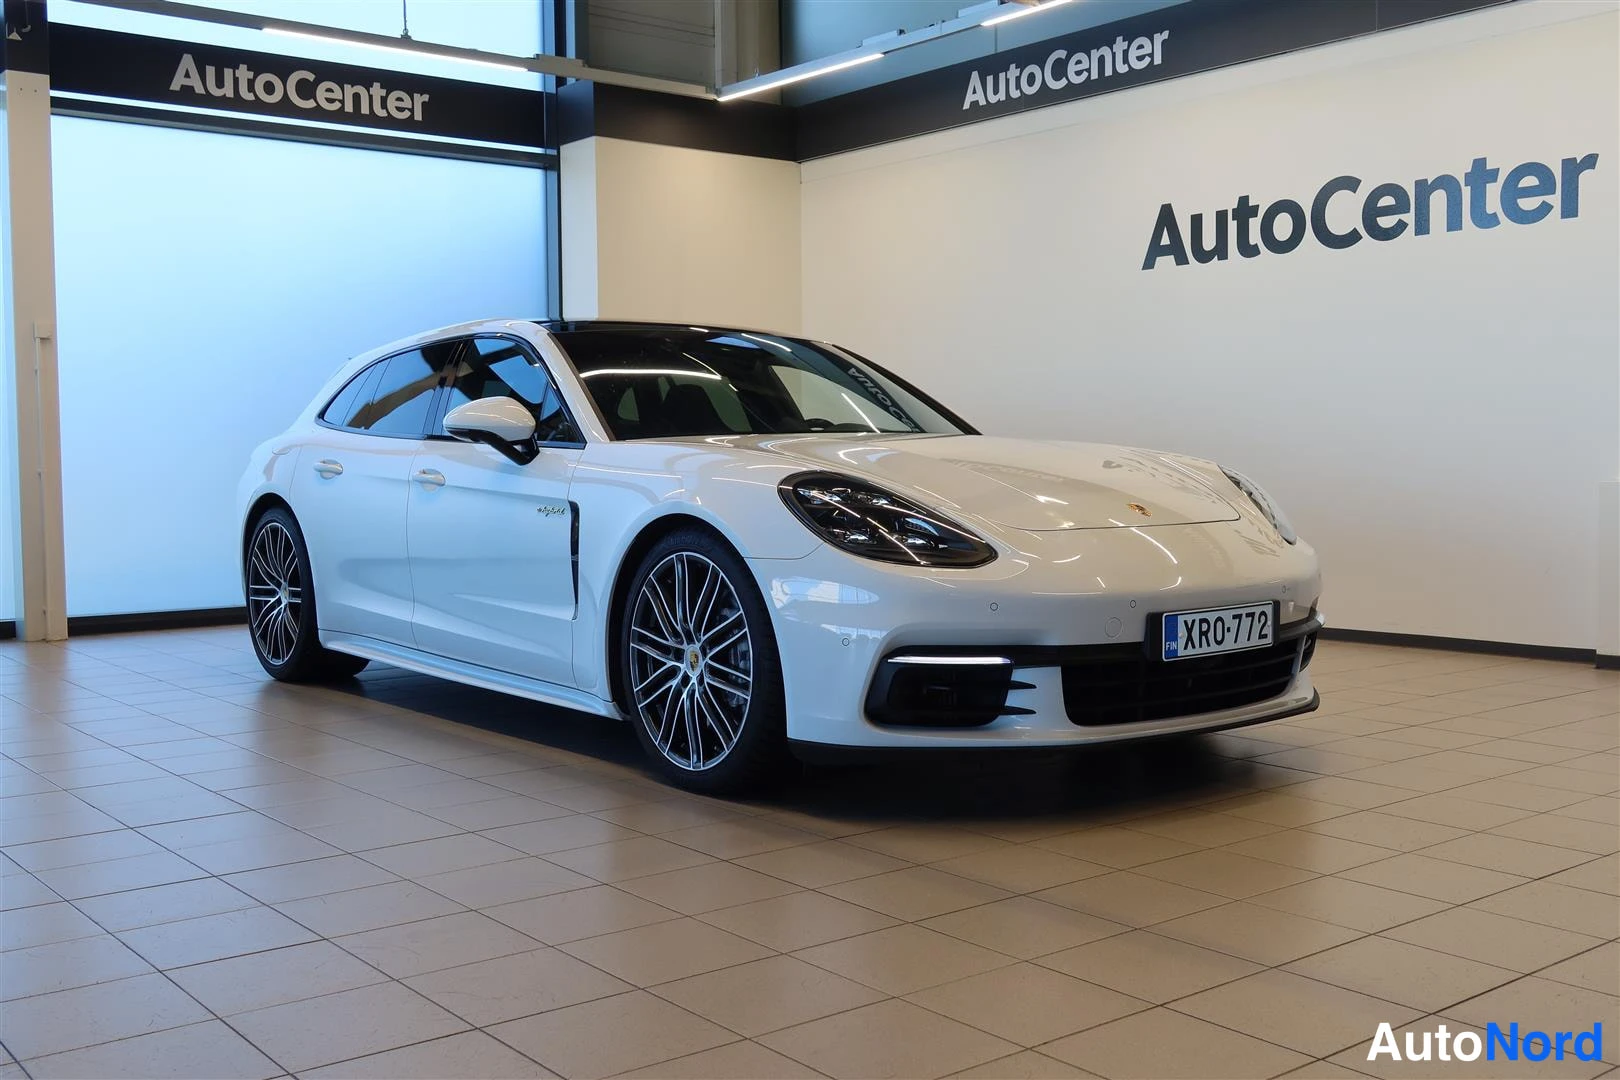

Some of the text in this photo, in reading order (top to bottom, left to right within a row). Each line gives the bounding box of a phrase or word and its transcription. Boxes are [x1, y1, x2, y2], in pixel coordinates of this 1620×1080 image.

[170, 54, 430, 121] AutoCenter
[963, 30, 1170, 110] AutoCenter
[1142, 153, 1599, 271] AutoCenter
[1165, 641, 1178, 651] FIN
[1183, 610, 1268, 650] XRO-772
